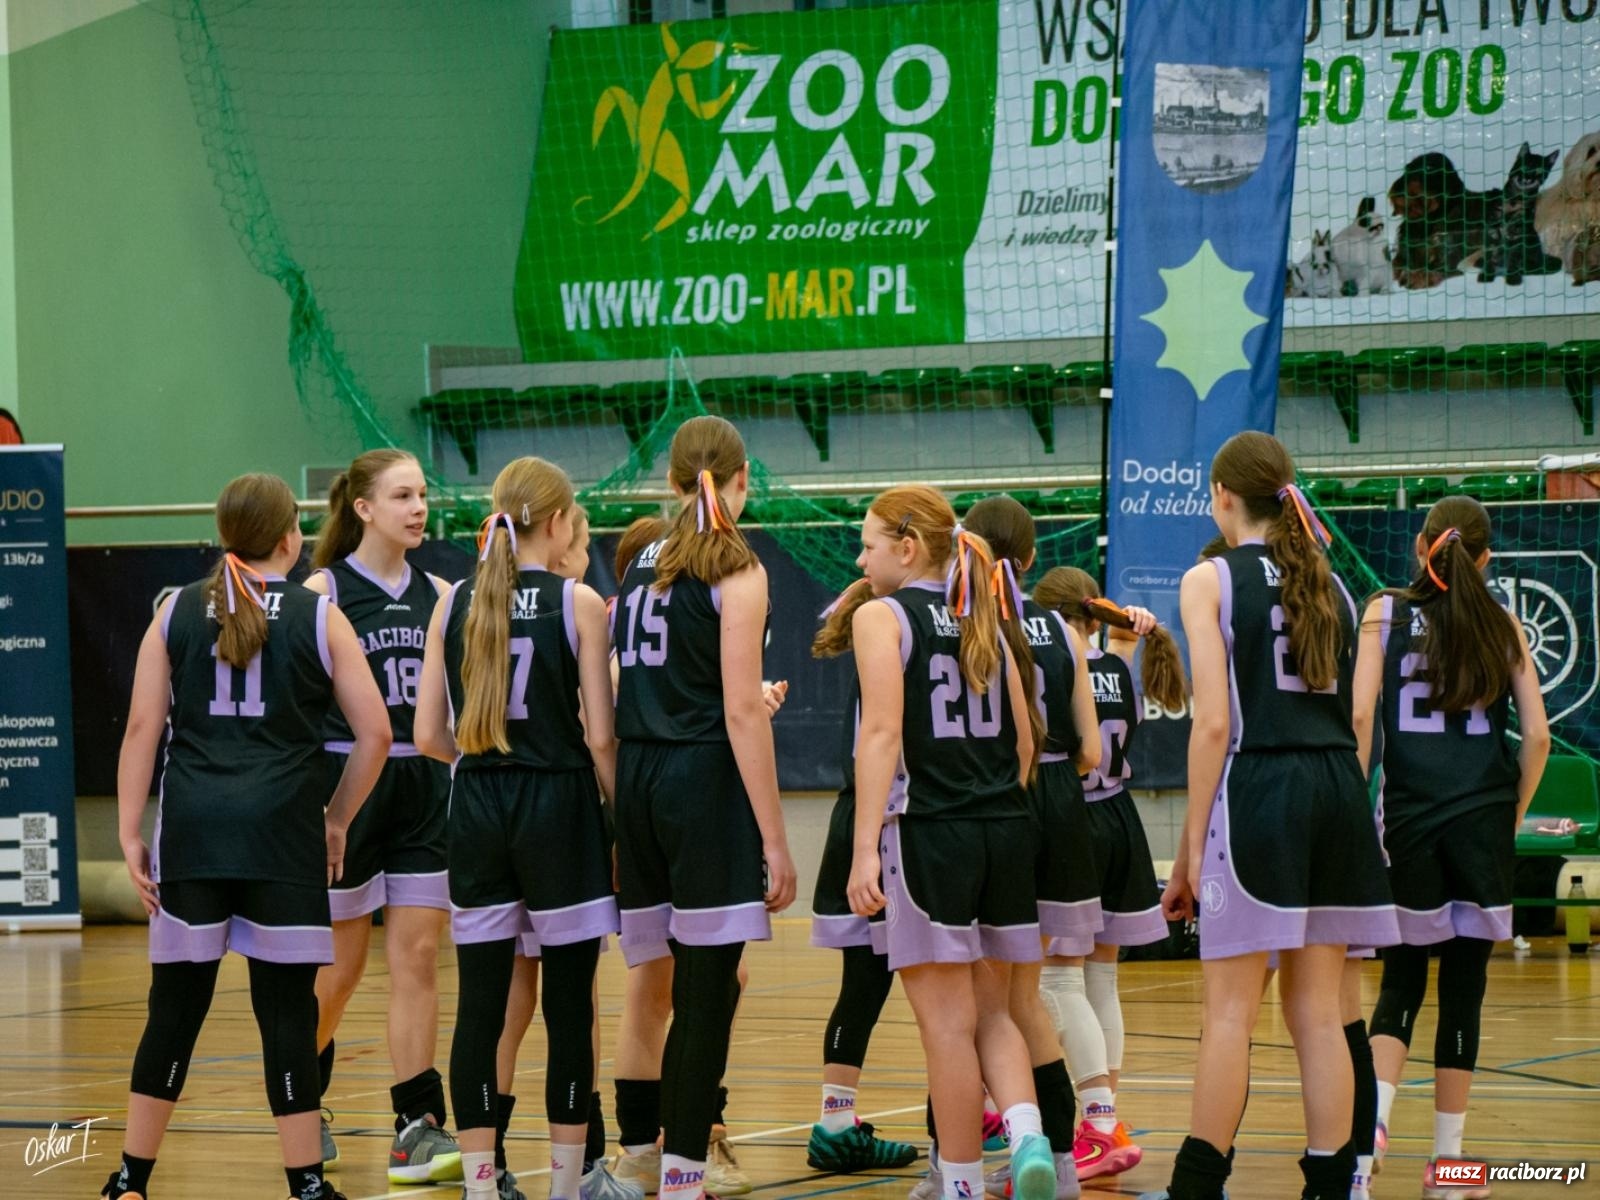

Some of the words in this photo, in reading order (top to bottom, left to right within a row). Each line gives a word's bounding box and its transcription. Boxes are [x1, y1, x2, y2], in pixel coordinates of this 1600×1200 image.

[1034, 0, 1124, 64] WS
[719, 43, 951, 132] ZOO
[1031, 74, 1123, 147] DO
[1387, 43, 1507, 121] ZOO
[692, 133, 936, 215] MAR
[685, 220, 757, 244] sklep
[767, 217, 930, 242] zoologiczny
[560, 265, 916, 331] WWW.ZOO-MAR.PL
[1120, 490, 1151, 515] od
[1123, 459, 1203, 491] Dodaj
[3, 552, 44, 567] 13b/2a
[621, 584, 673, 668] 15
[383, 657, 424, 707] 18
[929, 653, 1002, 739] 20
